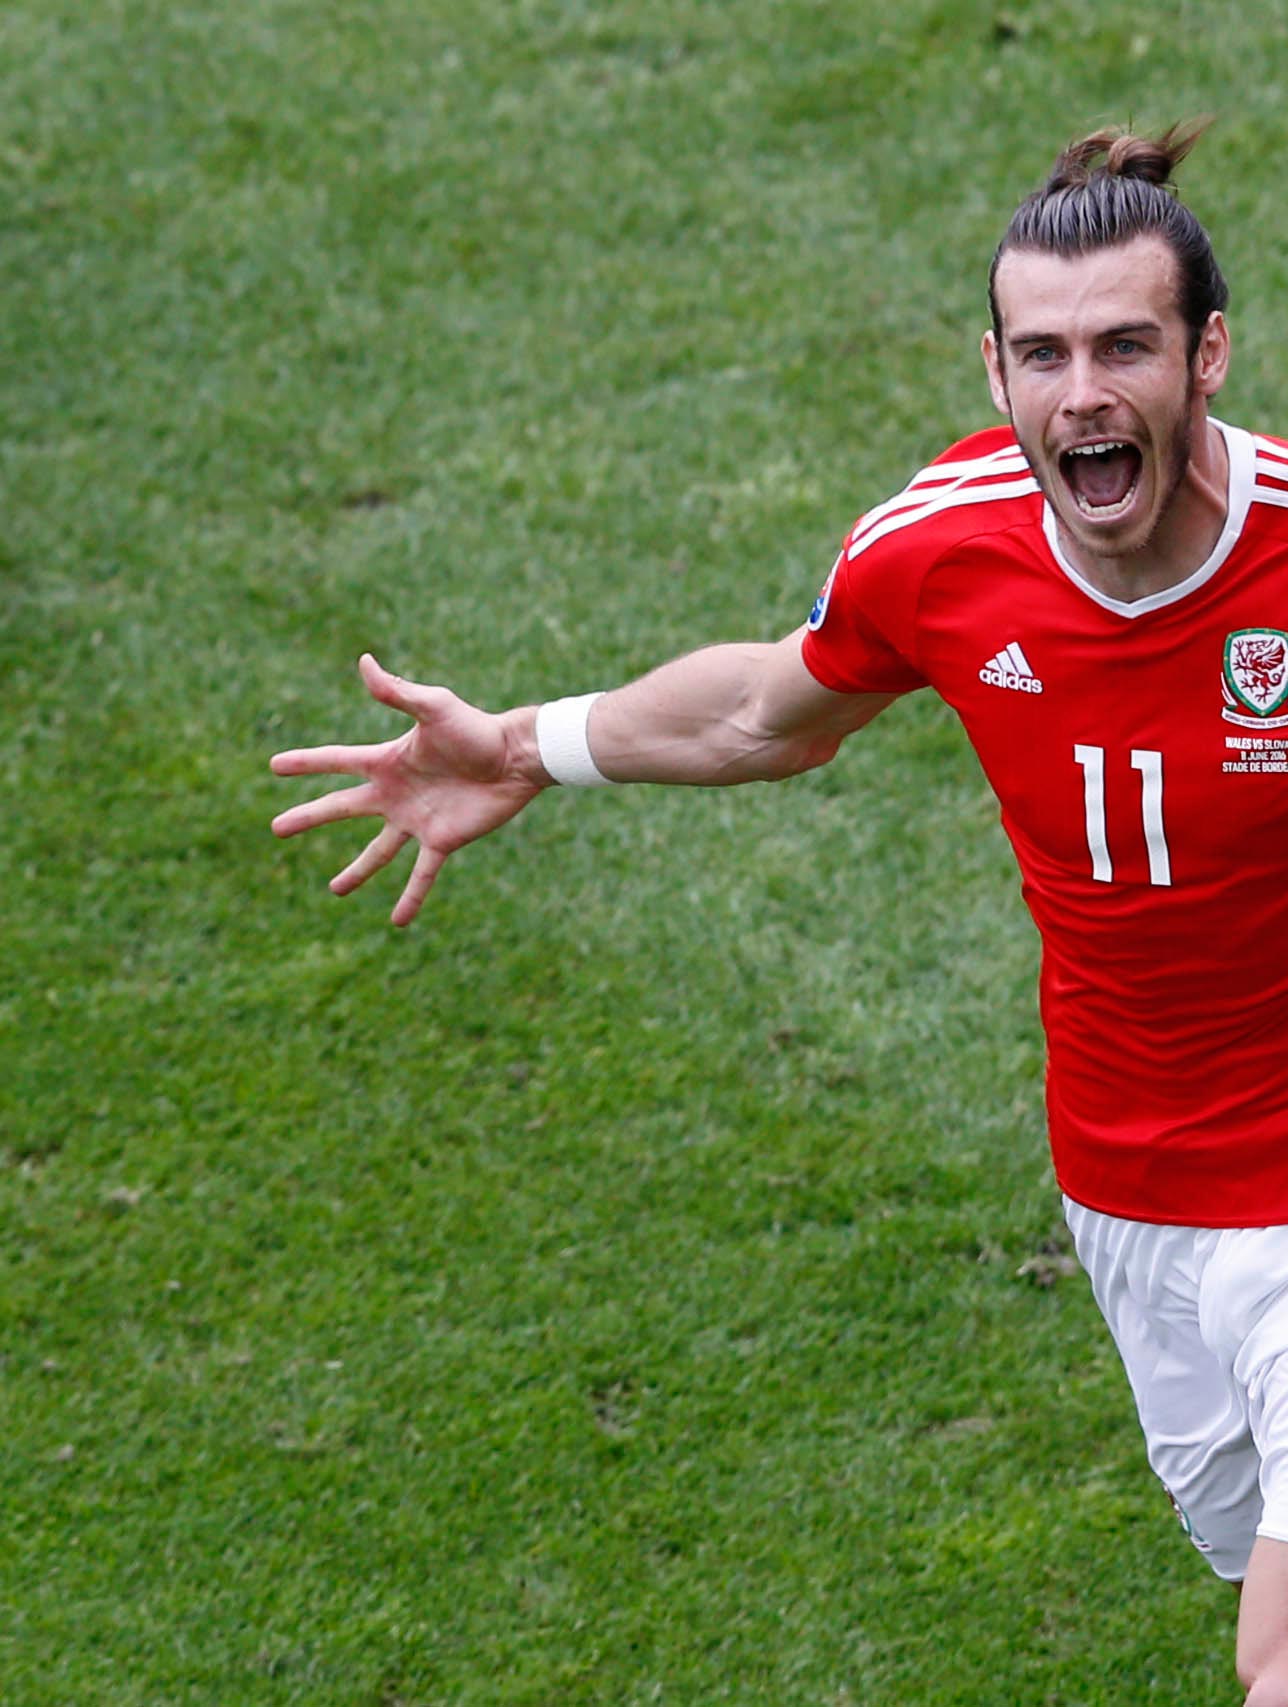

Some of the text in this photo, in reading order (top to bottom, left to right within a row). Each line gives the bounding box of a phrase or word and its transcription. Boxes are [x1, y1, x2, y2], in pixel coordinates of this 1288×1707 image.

[978, 668, 1043, 694] adidas
[1225, 736, 1252, 750] WALES
[1252, 738, 1263, 750] VS
[1248, 751, 1268, 761] JUNE
[1222, 761, 1249, 773] STADE
[1249, 761, 1261, 773] DE
[1074, 743, 1172, 887] 11
